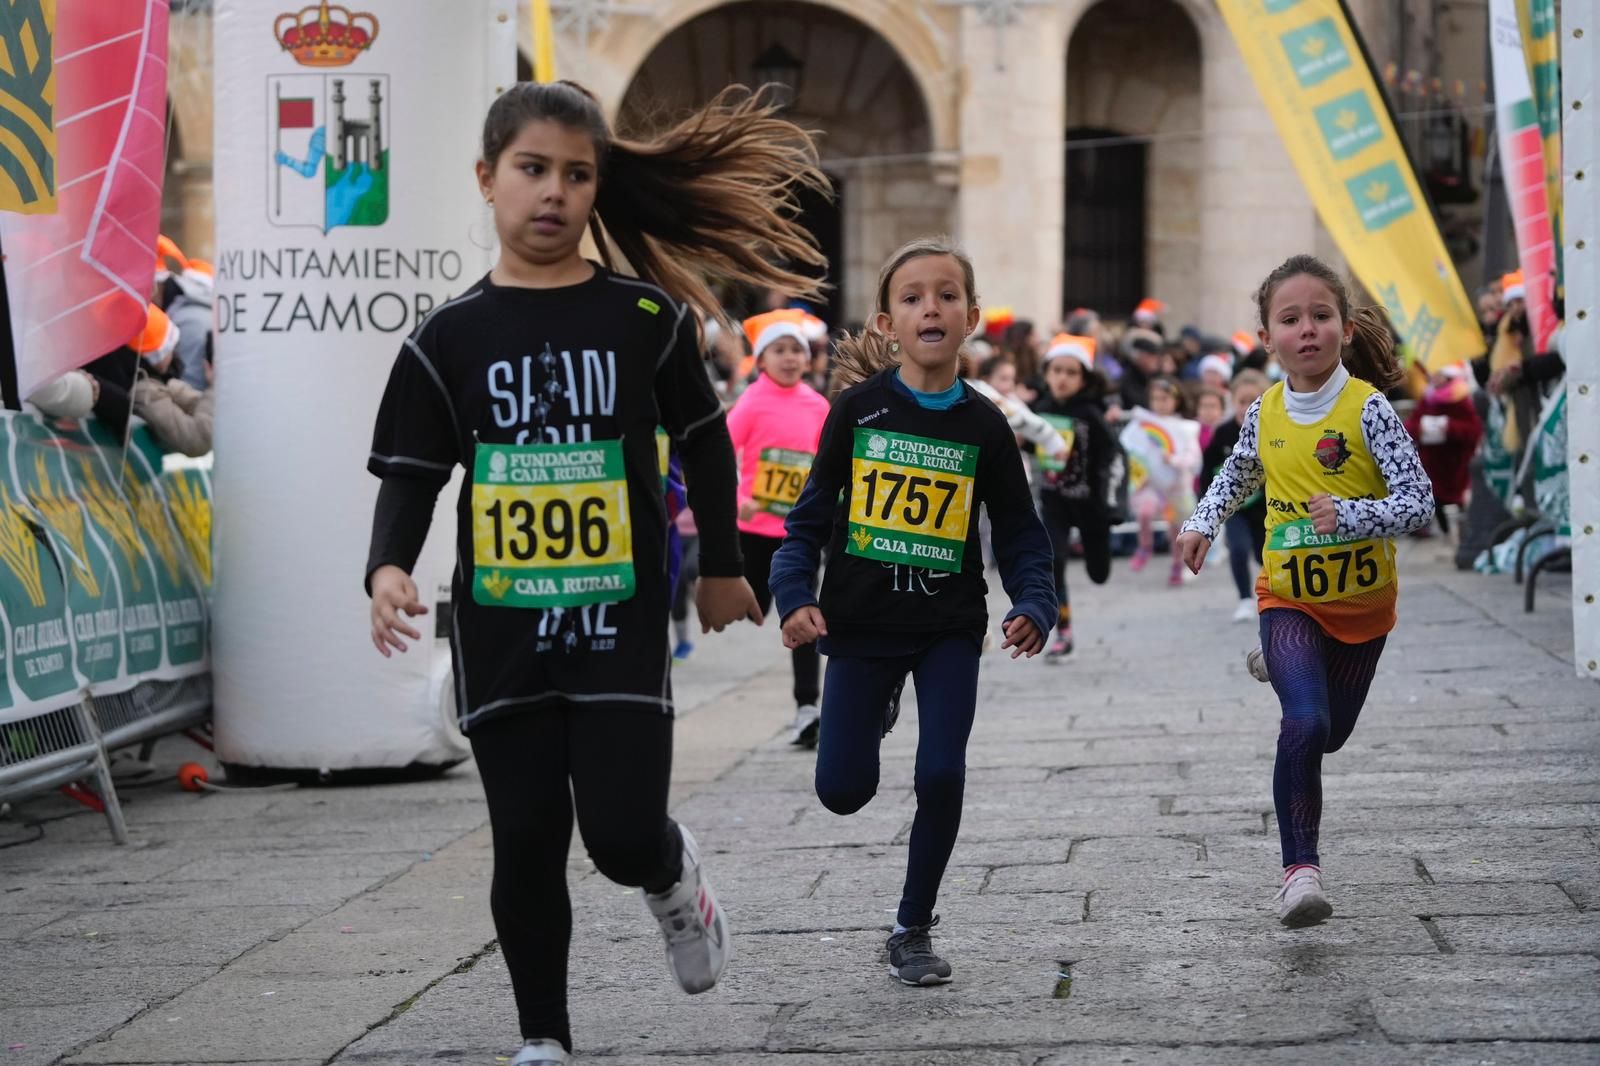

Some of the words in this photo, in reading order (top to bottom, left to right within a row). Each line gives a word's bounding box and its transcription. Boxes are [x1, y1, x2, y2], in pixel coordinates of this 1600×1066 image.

[218, 249, 462, 281] AYUNTAMIENTO
[218, 294, 247, 333] DE
[261, 292, 450, 333] ZAMOR
[510, 449, 606, 468] FUNDACION
[889, 450, 919, 465] CAJA
[922, 455, 963, 472] RURAL
[890, 439, 965, 461] FUNDACION
[511, 468, 550, 483] CAJA
[553, 464, 607, 480] RURAL
[764, 468, 809, 499] 179
[862, 469, 959, 529] 1757
[485, 497, 610, 560] 1396
[1303, 534, 1334, 546] CAJA
[873, 537, 909, 554] CAJA
[911, 543, 957, 562] RURAL
[514, 578, 559, 594] CAJA
[562, 574, 626, 593] RURAL
[1281, 545, 1378, 599] 1675
